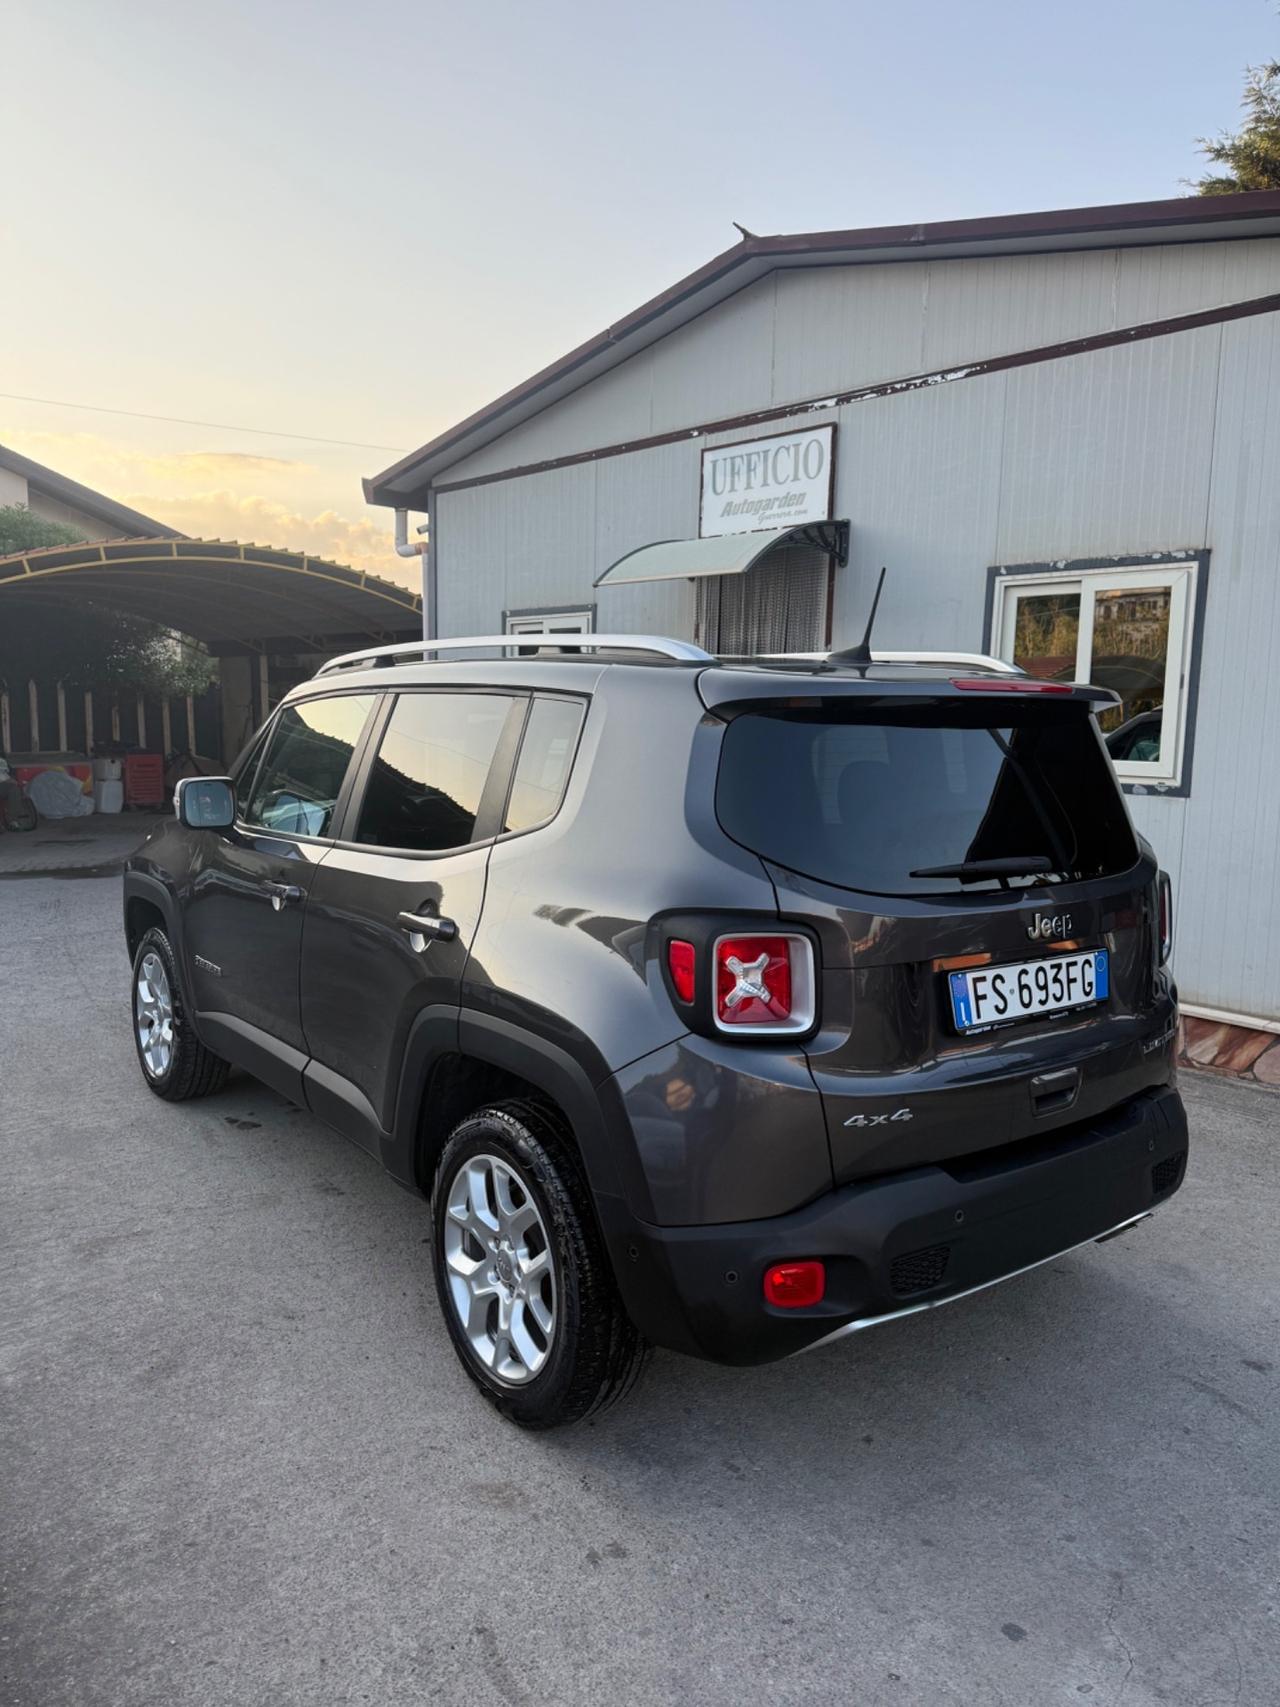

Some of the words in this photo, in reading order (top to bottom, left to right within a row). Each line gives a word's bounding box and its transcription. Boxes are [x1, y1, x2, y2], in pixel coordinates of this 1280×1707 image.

[710, 439, 824, 496] UFFICIO
[720, 491, 807, 518] Autogarden
[1028, 913, 1072, 939] Jeep
[972, 973, 1009, 1020] FS
[1017, 958, 1094, 1009] 693FG
[843, 1108, 913, 1128] 4x4
